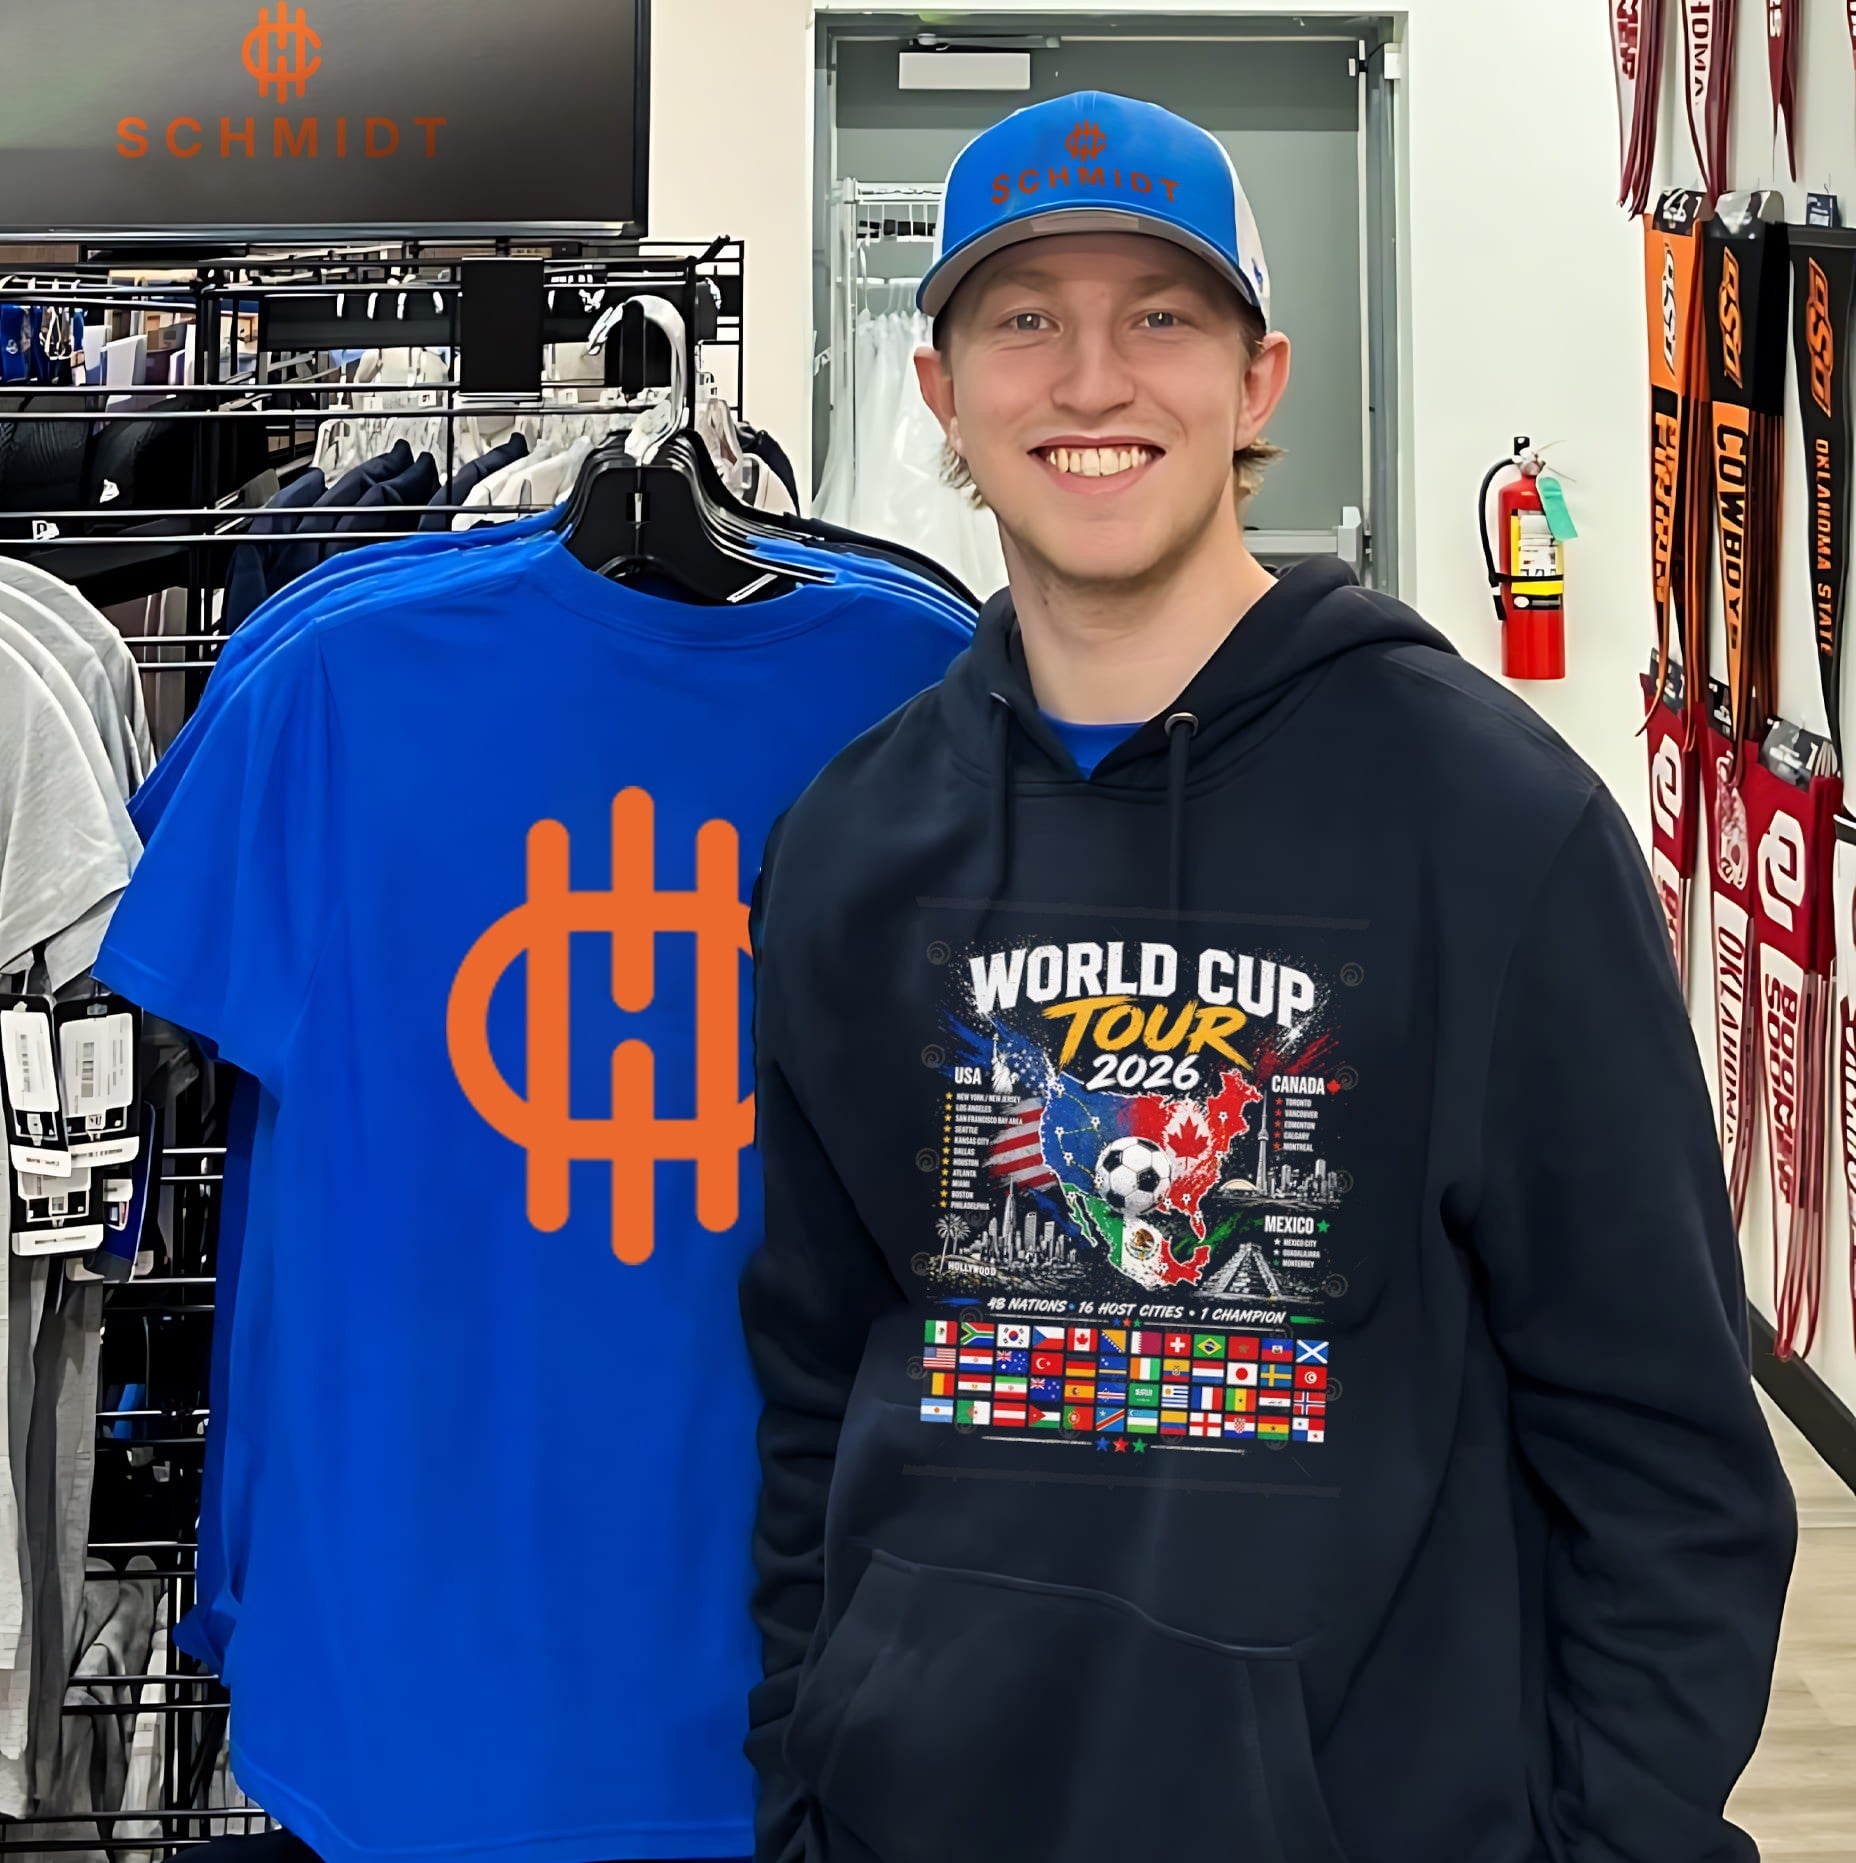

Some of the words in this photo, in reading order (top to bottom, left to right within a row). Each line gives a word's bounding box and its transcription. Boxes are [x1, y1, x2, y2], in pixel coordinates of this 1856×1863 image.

[115, 116, 447, 158] SCHMIDT
[991, 166, 1179, 204] SCHMIDT
[1815, 438, 1832, 570] OKLAHOMA
[1716, 423, 1748, 650] COWBOY
[968, 941, 1178, 1015] WORLD
[1197, 948, 1315, 1029] CUP
[1041, 995, 1253, 1070] TOUR
[954, 1066, 982, 1085] USA
[1086, 1053, 1200, 1091] 2026
[1271, 1075, 1326, 1095] CANADA
[1001, 1095, 1021, 1104] JERSEY
[1285, 1098, 1312, 1107] TORONTO
[955, 1103, 967, 1112] LOS
[967, 1104, 992, 1113] ANGELES
[955, 1114, 967, 1122] SAN
[967, 1115, 997, 1124] FRANCISCO
[1284, 1109, 1319, 1119] VANCOUVER
[1283, 1120, 1316, 1130] EDMONTON
[954, 1126, 979, 1135] SEATTLE
[954, 1136, 976, 1145] KANSAS
[976, 1137, 990, 1146] CITY
[1283, 1131, 1310, 1141] CALGARY
[953, 1147, 975, 1156] DALLAS
[1283, 1142, 1314, 1152] MONTREAL
[952, 1158, 979, 1167] HOUSTON
[952, 1169, 977, 1178] ATLANTA
[951, 1179, 971, 1188] MIAMI
[951, 1190, 974, 1200] BOSTON
[950, 1201, 991, 1211] PHILADELPHIA
[1264, 1215, 1315, 1235] MEXICO
[1282, 1238, 1305, 1247] MEXICO
[1304, 1239, 1317, 1248] CITY
[1282, 1248, 1321, 1259] GUADALAJARA
[948, 1261, 997, 1277] HOLLYWOOD
[1282, 1259, 1315, 1269] MONTERREY
[987, 1297, 1006, 1311] 48
[1008, 1298, 1067, 1313] NATIONS
[1078, 1301, 1094, 1314] 16
[1097, 1302, 1137, 1316] HOST
[1139, 1304, 1185, 1319] CITIES
[1200, 1307, 1210, 1321] 1
[1211, 1308, 1287, 1325] CHAMPION
